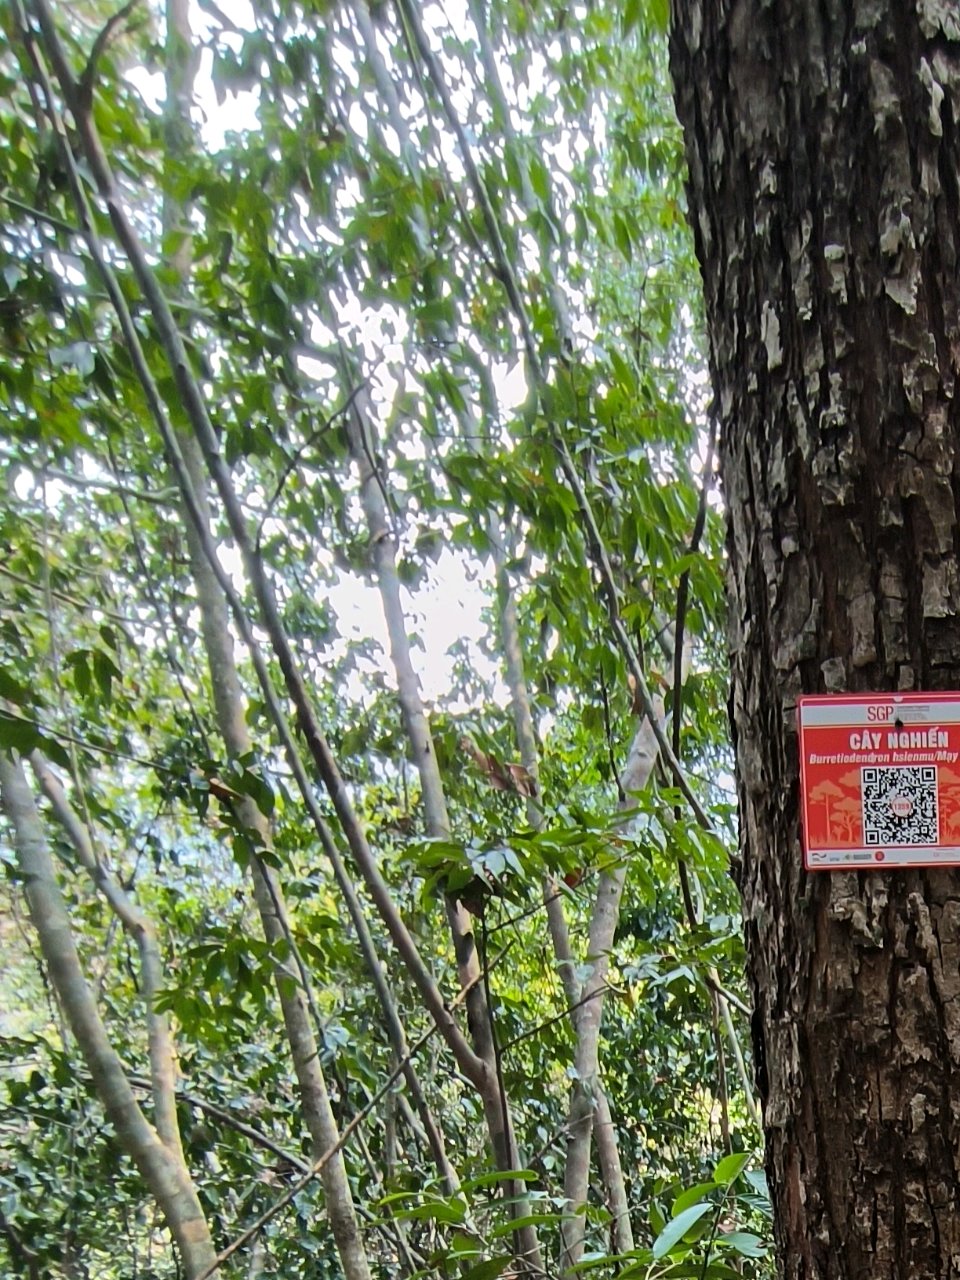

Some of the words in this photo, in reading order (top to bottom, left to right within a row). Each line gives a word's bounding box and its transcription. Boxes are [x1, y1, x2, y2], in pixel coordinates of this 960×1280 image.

[867, 705, 894, 721] SGP
[849, 729, 881, 750] CÂY
[887, 726, 948, 749] NGHIẾN
